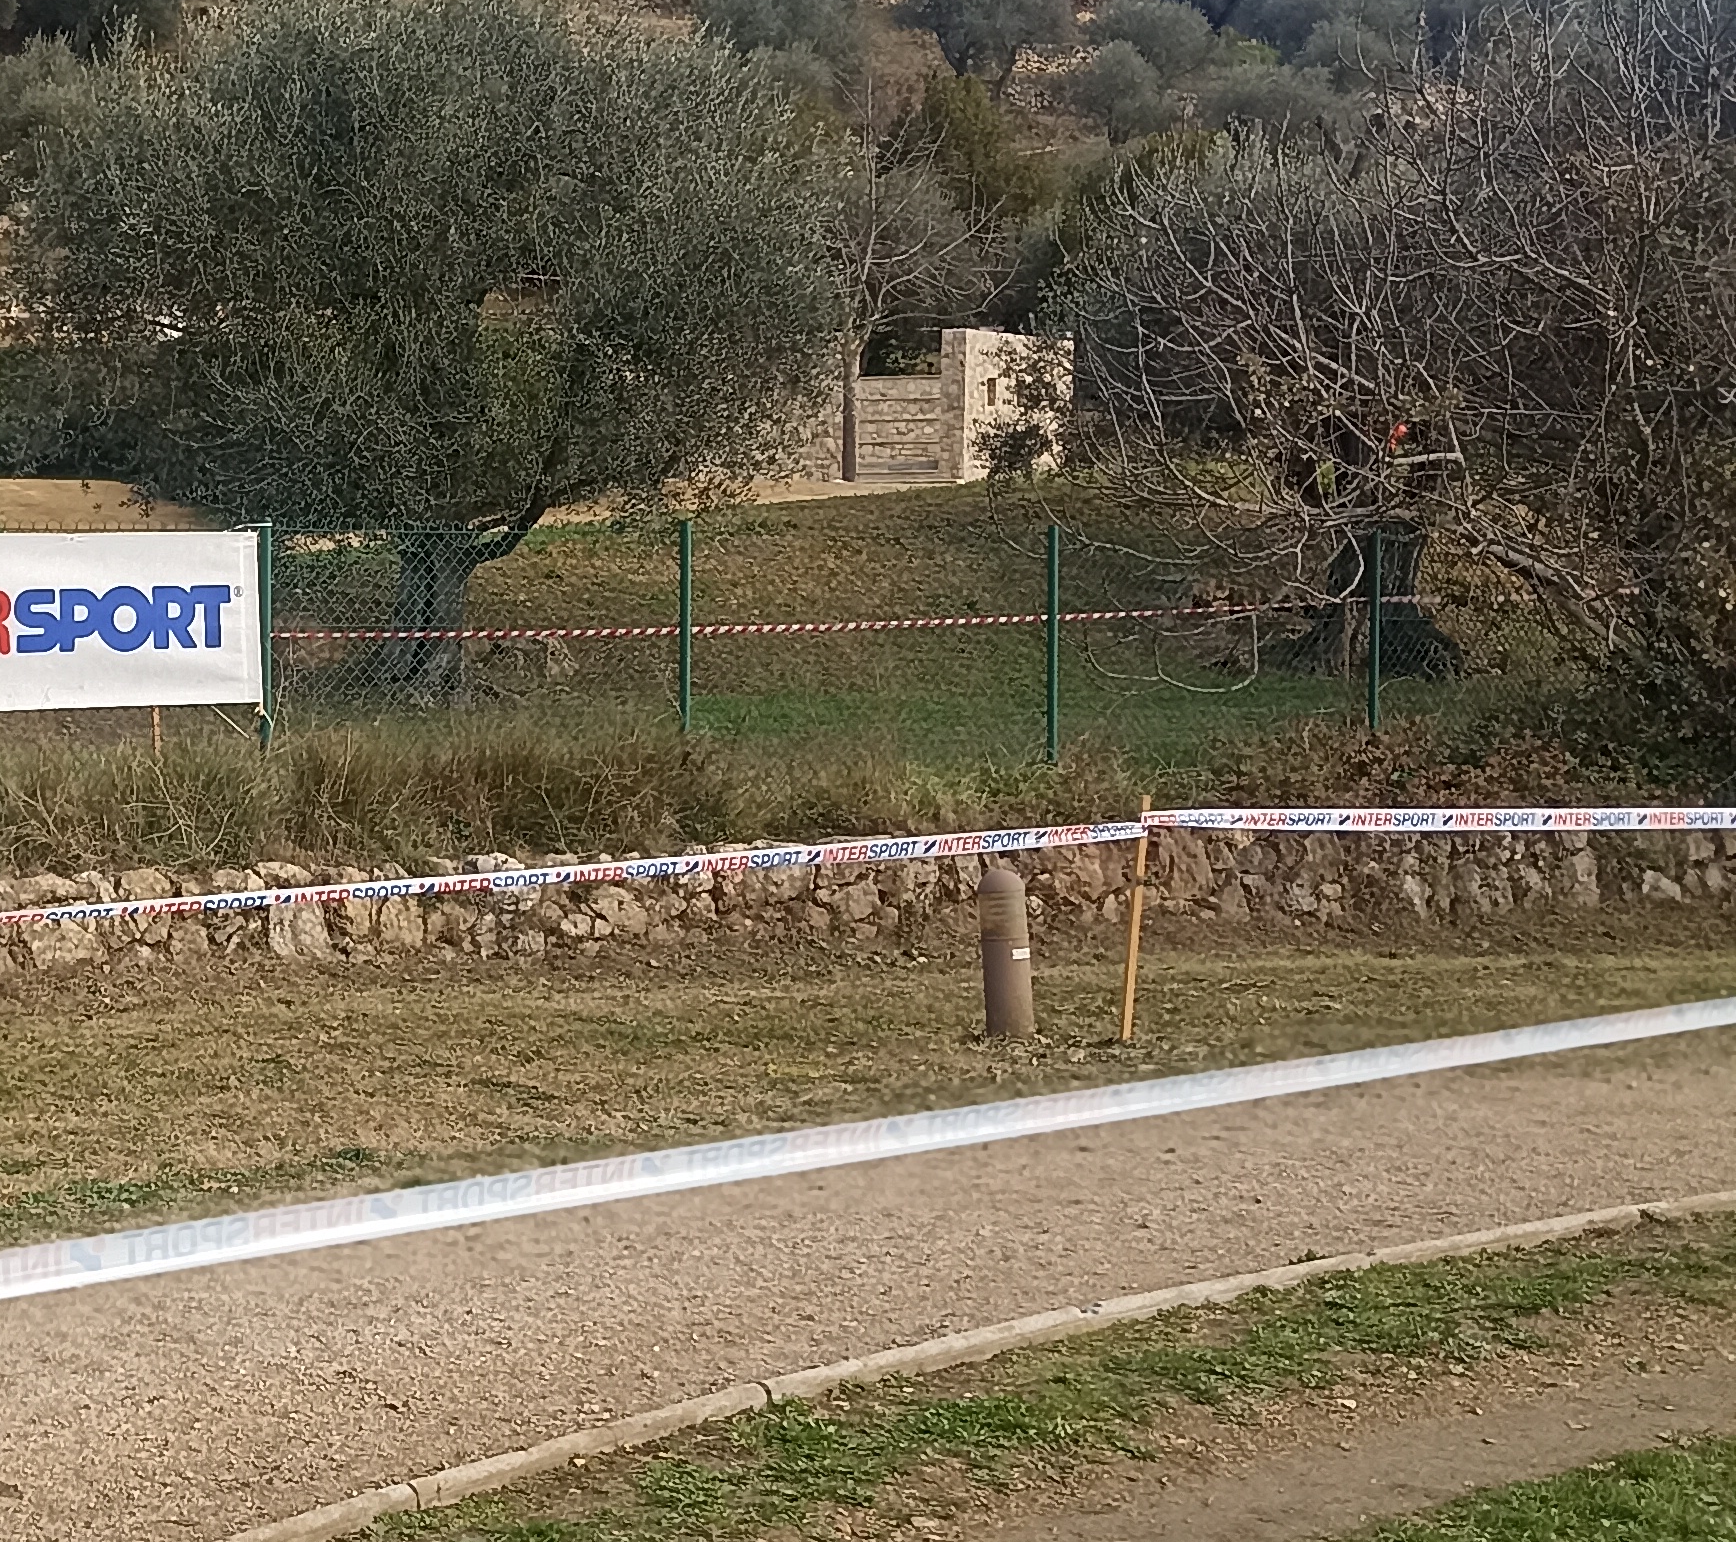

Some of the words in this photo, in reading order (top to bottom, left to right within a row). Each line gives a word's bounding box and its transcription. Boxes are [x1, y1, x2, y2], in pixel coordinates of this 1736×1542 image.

[1242, 811, 1334, 828] INTERSPORT
[1351, 811, 1437, 828] INTERSPORT
[1453, 811, 1537, 827] INTERSPORT
[1553, 811, 1633, 827] INTERSPORT
[1648, 810, 1726, 827] INTERSPORT
[700, 849, 803, 873] INTERSPORT
[821, 839, 919, 863] INTERSPORT
[936, 830, 1032, 854] INTERSPORT
